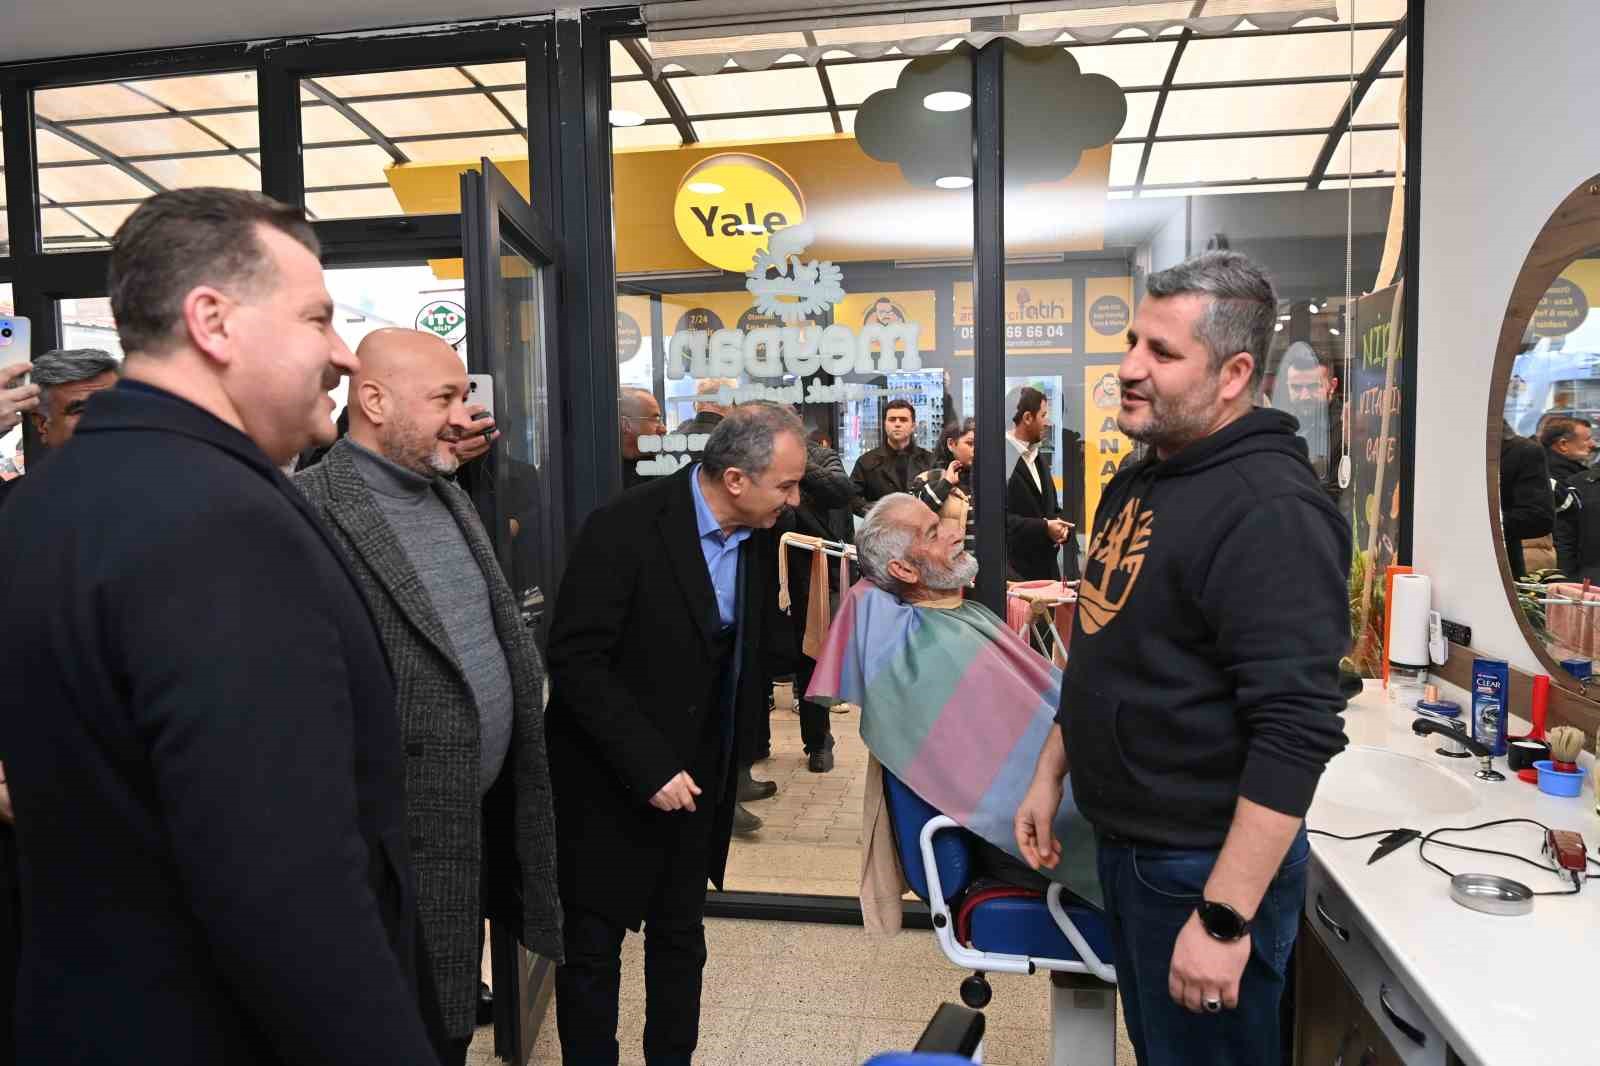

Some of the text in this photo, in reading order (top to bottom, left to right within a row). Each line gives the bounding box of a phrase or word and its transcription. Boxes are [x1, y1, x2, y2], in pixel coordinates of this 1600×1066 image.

[690, 203, 788, 238] Yale
[1006, 326, 1022, 338] 66
[1026, 326, 1042, 338] 66
[1047, 325, 1064, 337] 04
[1366, 436, 1397, 464] CAE
[1476, 678, 1501, 689] CLEAR
